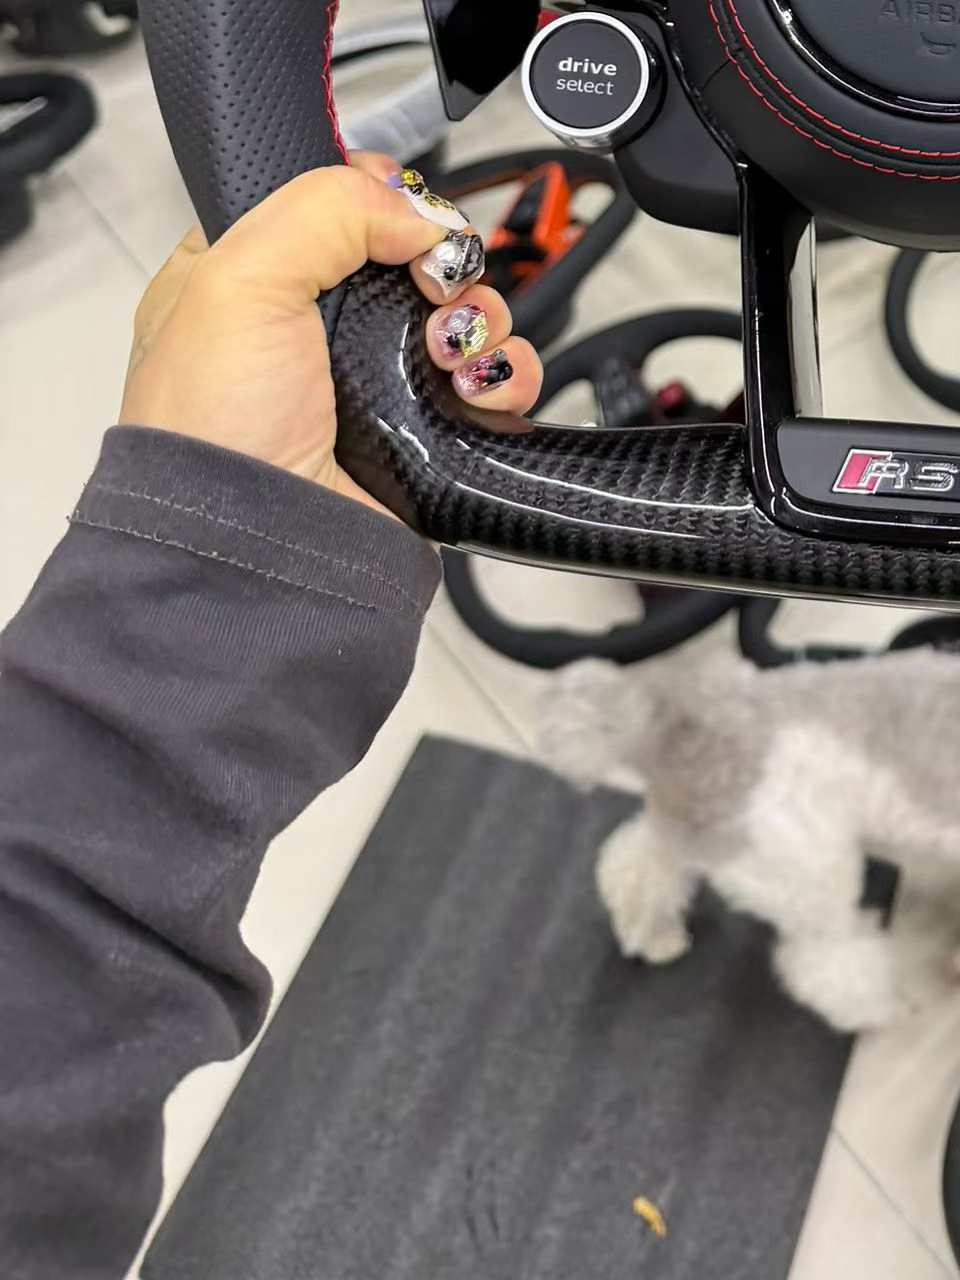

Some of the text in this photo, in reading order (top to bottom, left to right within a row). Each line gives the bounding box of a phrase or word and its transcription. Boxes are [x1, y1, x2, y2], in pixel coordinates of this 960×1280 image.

[558, 56, 618, 76] drive
[556, 78, 615, 96] select
[852, 456, 960, 492] RS
